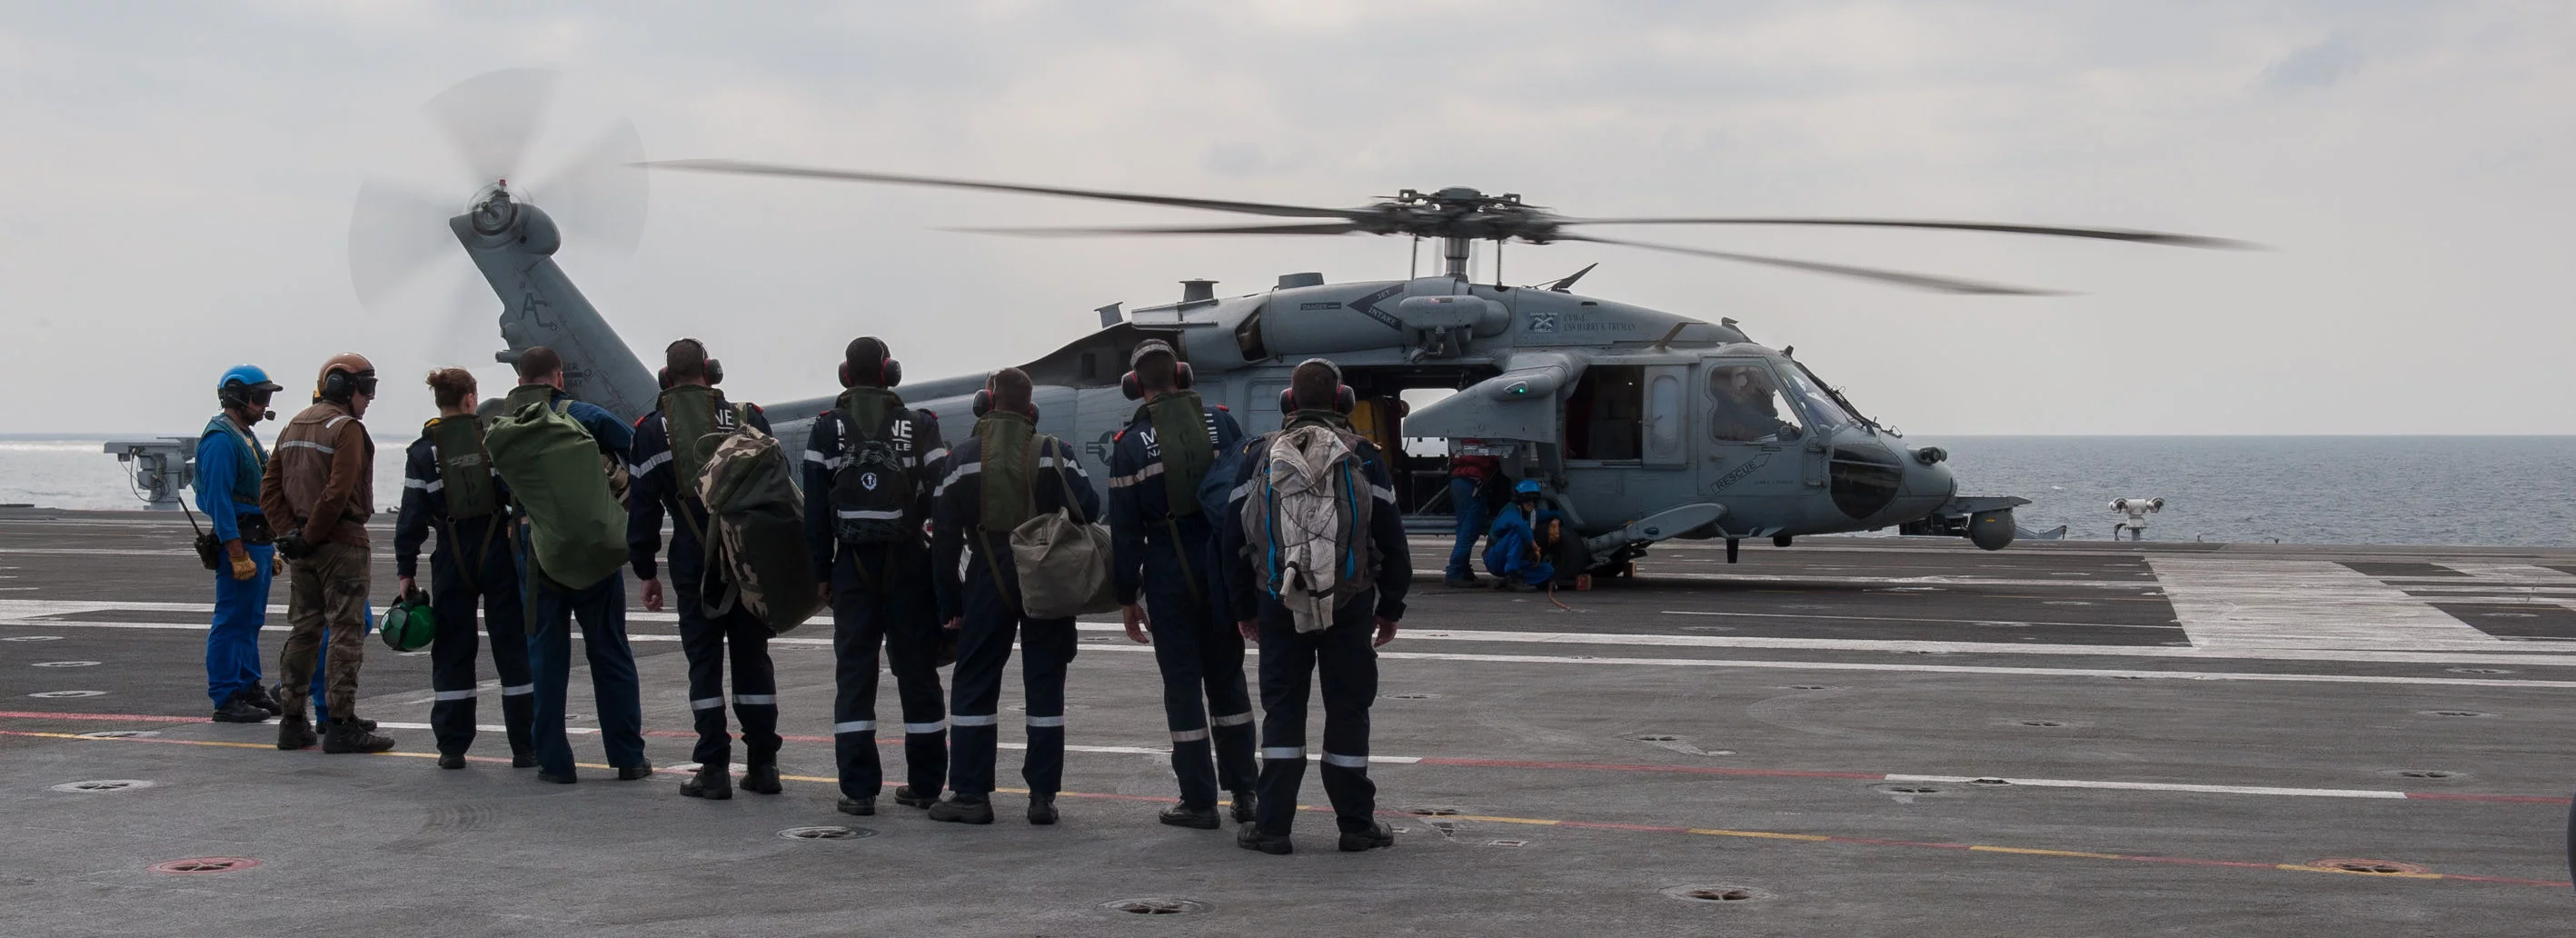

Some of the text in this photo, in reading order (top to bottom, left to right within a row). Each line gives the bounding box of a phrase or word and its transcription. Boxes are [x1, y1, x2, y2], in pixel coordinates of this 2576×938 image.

[1377, 290, 1391, 299] JET
[1368, 306, 1397, 326] INTAKE
[1576, 323, 1599, 332] HARRY
[1608, 323, 1636, 332] TRUMAN
[1715, 460, 1757, 490] RESCUE
